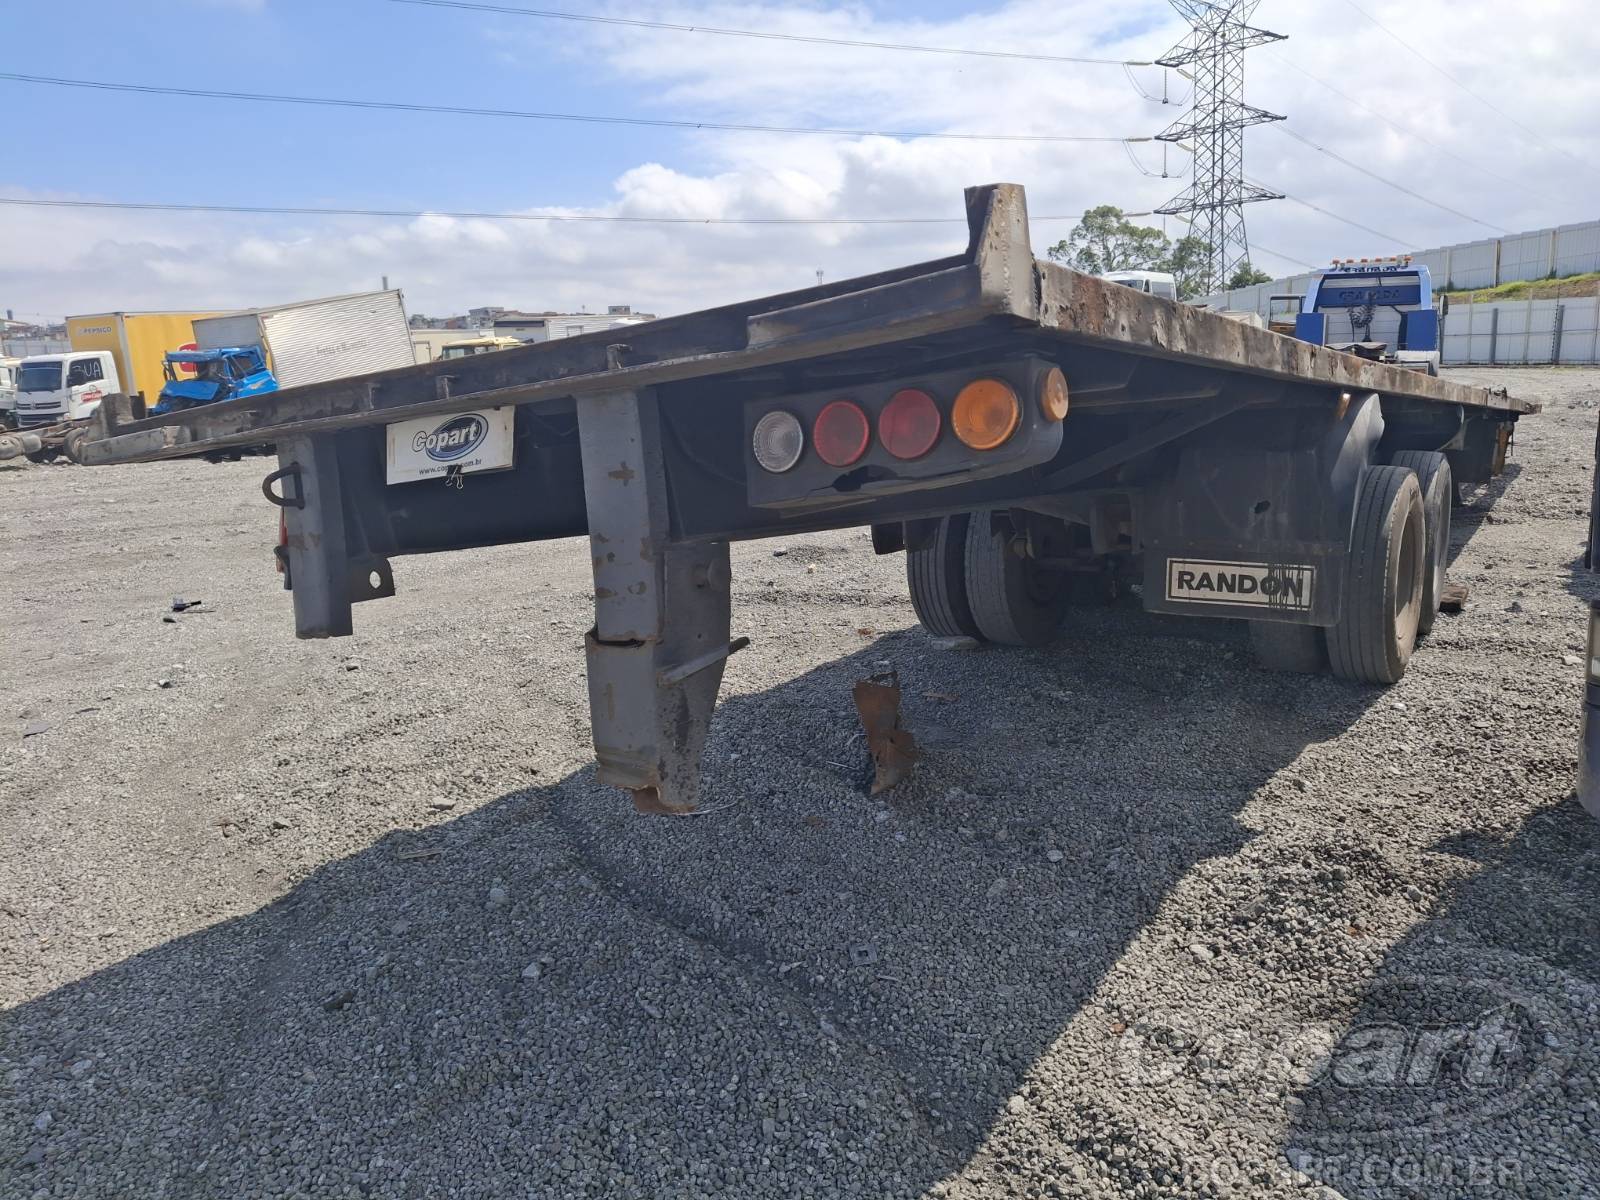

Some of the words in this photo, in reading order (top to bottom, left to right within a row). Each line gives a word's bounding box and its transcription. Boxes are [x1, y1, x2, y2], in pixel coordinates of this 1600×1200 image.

[412, 418, 480, 452] Copart
[419, 459, 482, 475] www.copcom.br
[1177, 570, 1303, 597] RANDON
